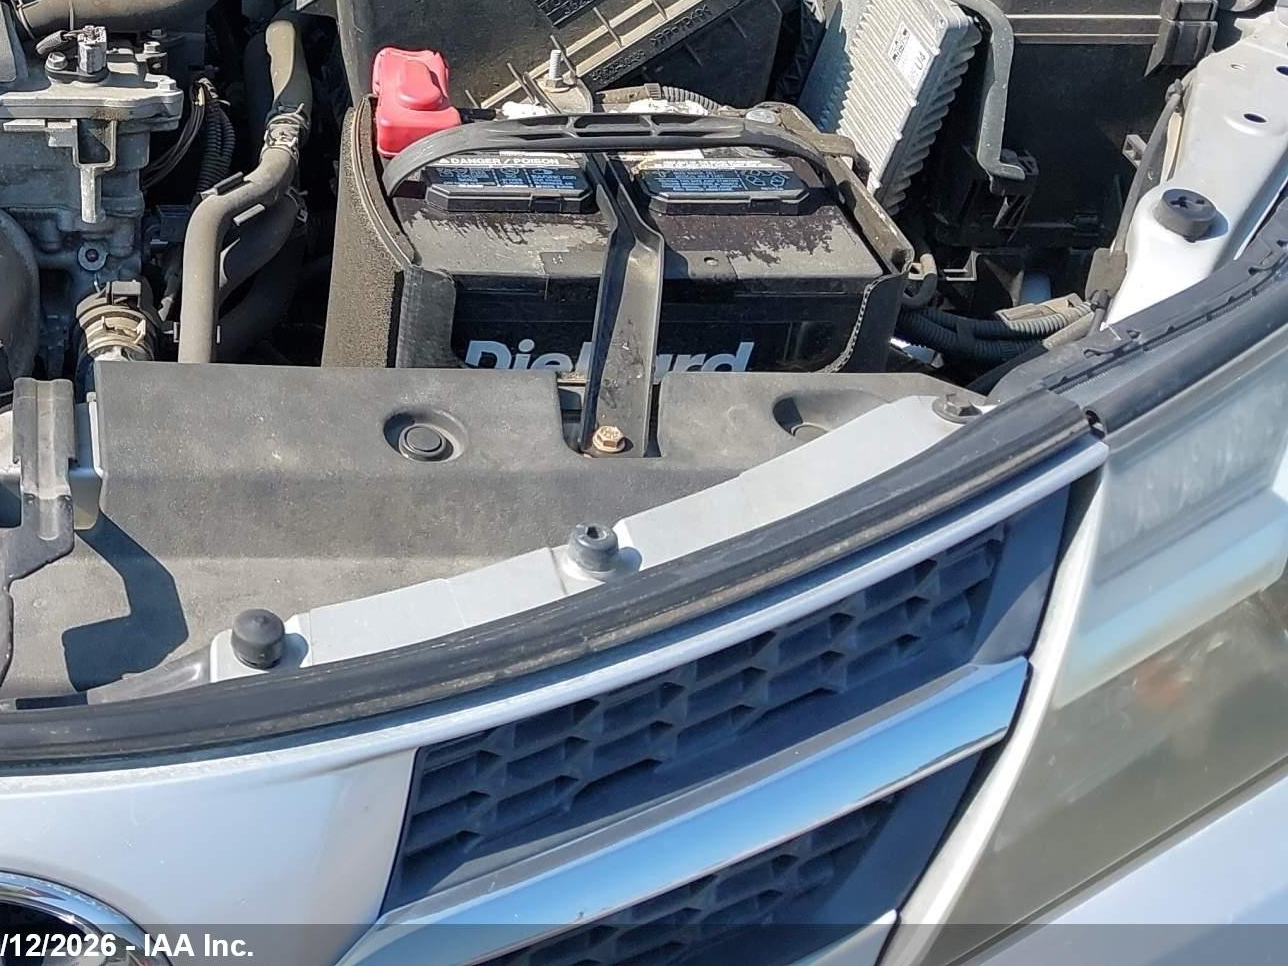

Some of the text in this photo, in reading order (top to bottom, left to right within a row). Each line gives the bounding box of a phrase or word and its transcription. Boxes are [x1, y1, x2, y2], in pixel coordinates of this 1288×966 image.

[450, 157, 501, 165] DANGER
[514, 157, 560, 165] POISON
[465, 339, 755, 372] Dierd
